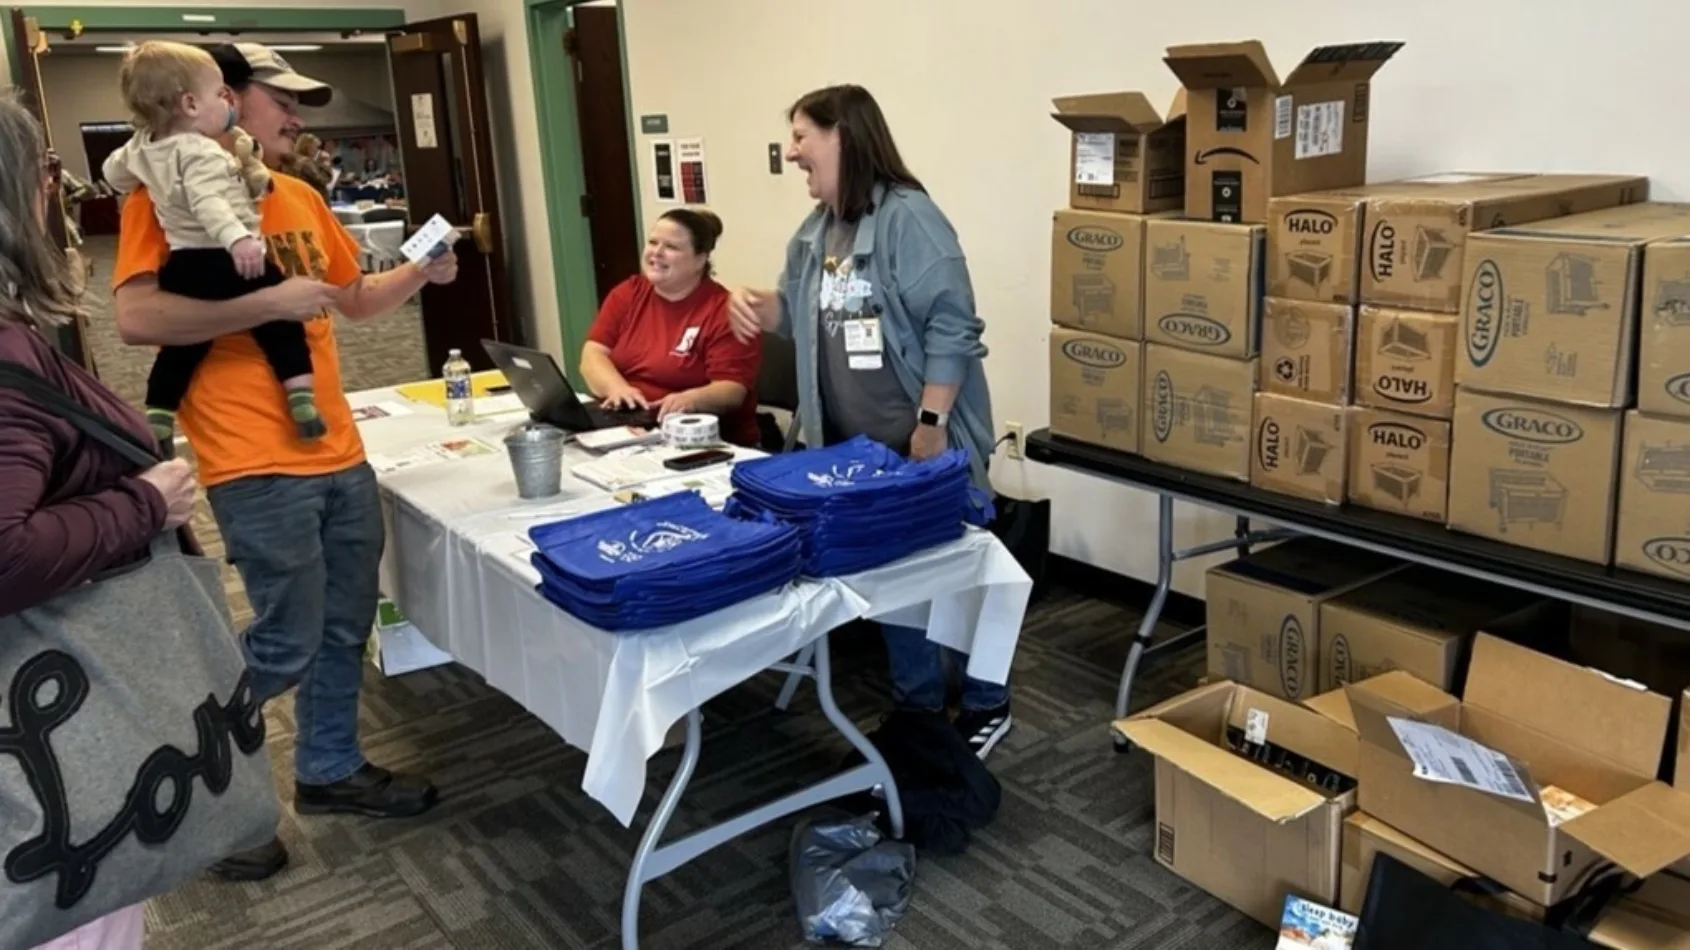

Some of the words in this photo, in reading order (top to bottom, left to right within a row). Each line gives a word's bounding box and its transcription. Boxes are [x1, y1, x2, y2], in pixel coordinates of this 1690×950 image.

[1073, 228, 1118, 246] GRACO
[1288, 218, 1333, 235] HALO
[1379, 226, 1395, 277] HALO
[1471, 270, 1494, 352] GRACO
[1166, 319, 1221, 340] GRACO
[1071, 343, 1121, 362] GRACO
[1378, 375, 1427, 395] HALO
[1157, 375, 1169, 434] GRACO
[1496, 412, 1575, 438] GRACO
[1266, 422, 1280, 468] HALO
[1374, 429, 1421, 450] HALO
[1286, 626, 1299, 693] GRACO
